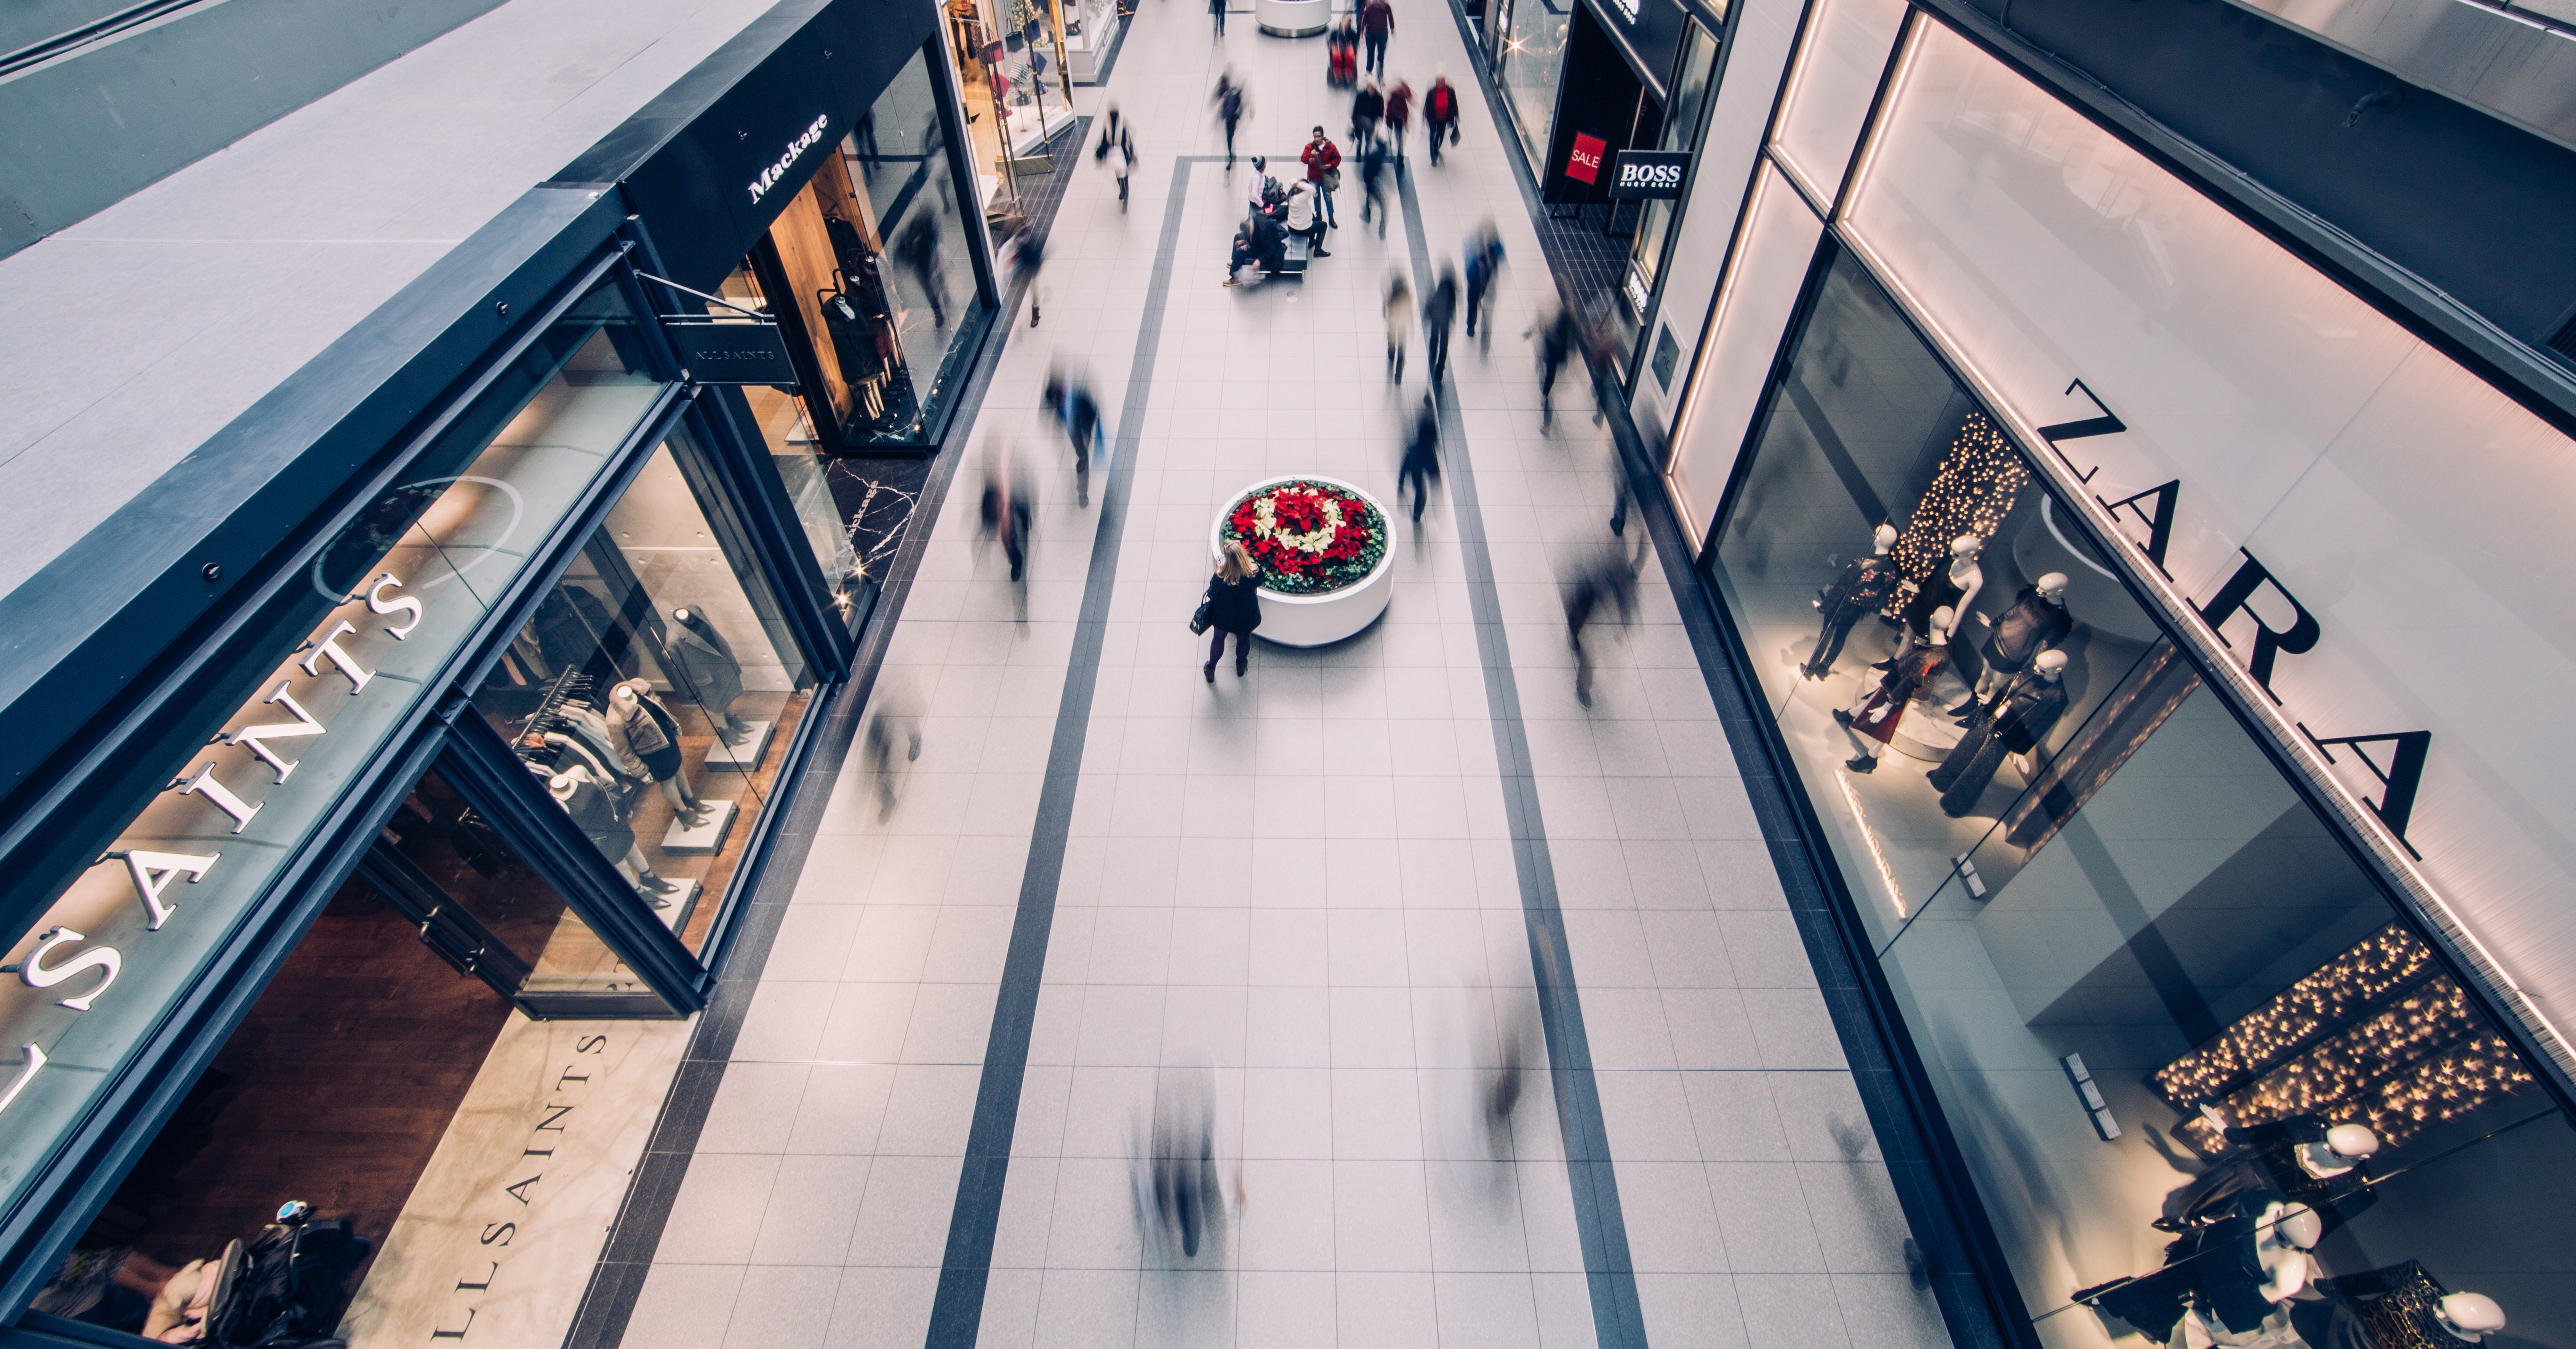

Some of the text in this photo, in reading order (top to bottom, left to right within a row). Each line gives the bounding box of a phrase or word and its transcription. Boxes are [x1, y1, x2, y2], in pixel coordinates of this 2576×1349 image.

[748, 114, 827, 204] Mackage
[1572, 149, 1600, 168] SALE
[1620, 164, 1681, 182] BOSS
[2036, 377, 2432, 862] ZARA
[0, 572, 423, 1115] SAINTS
